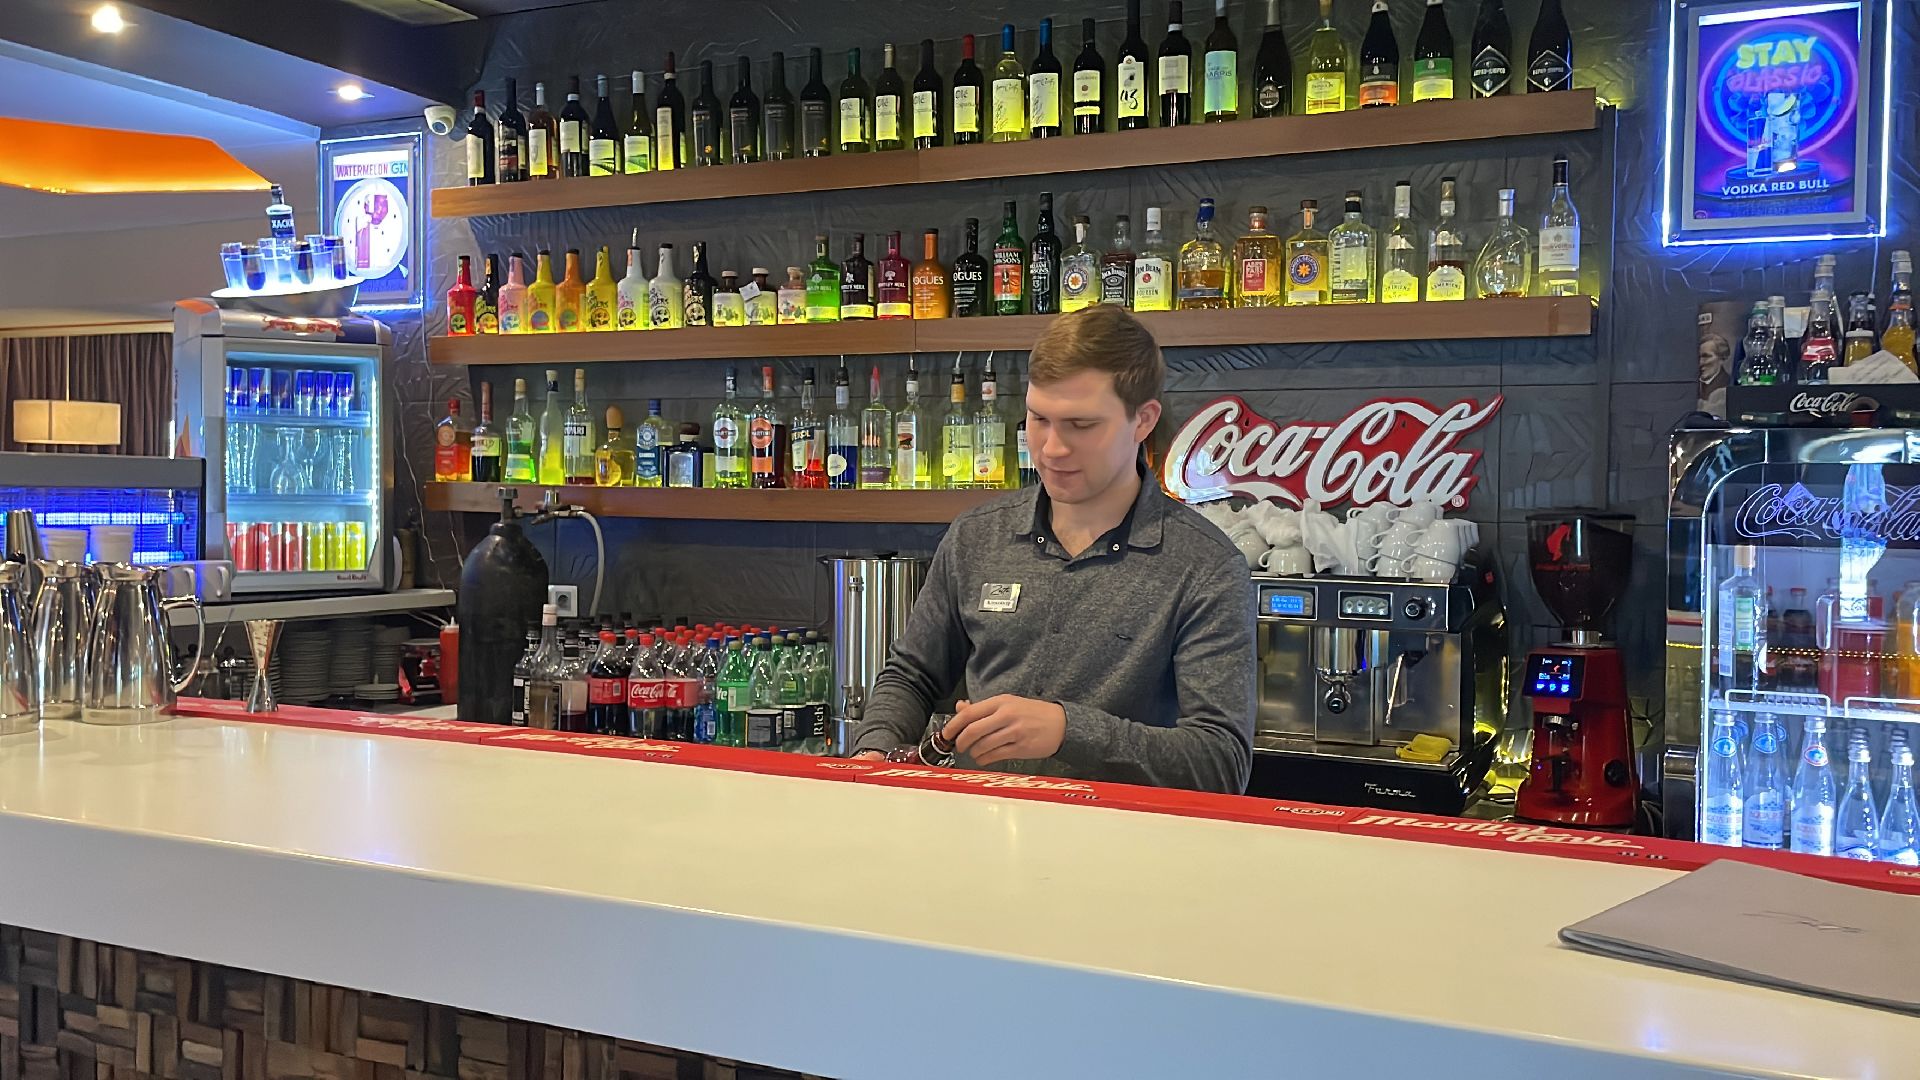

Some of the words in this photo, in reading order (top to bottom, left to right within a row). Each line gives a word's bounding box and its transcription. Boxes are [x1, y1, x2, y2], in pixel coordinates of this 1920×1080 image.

[1735, 37, 1818, 69] STAY
[336, 162, 389, 178] WATERMELON
[1722, 184, 1768, 196] VODKA
[1771, 181, 1795, 192] RED
[1799, 179, 1830, 190] BULL
[913, 276, 944, 285] OGUES
[951, 271, 982, 281] OGUES
[1164, 393, 1504, 506] Coca-Cola
[813, 705, 824, 735] Rich
